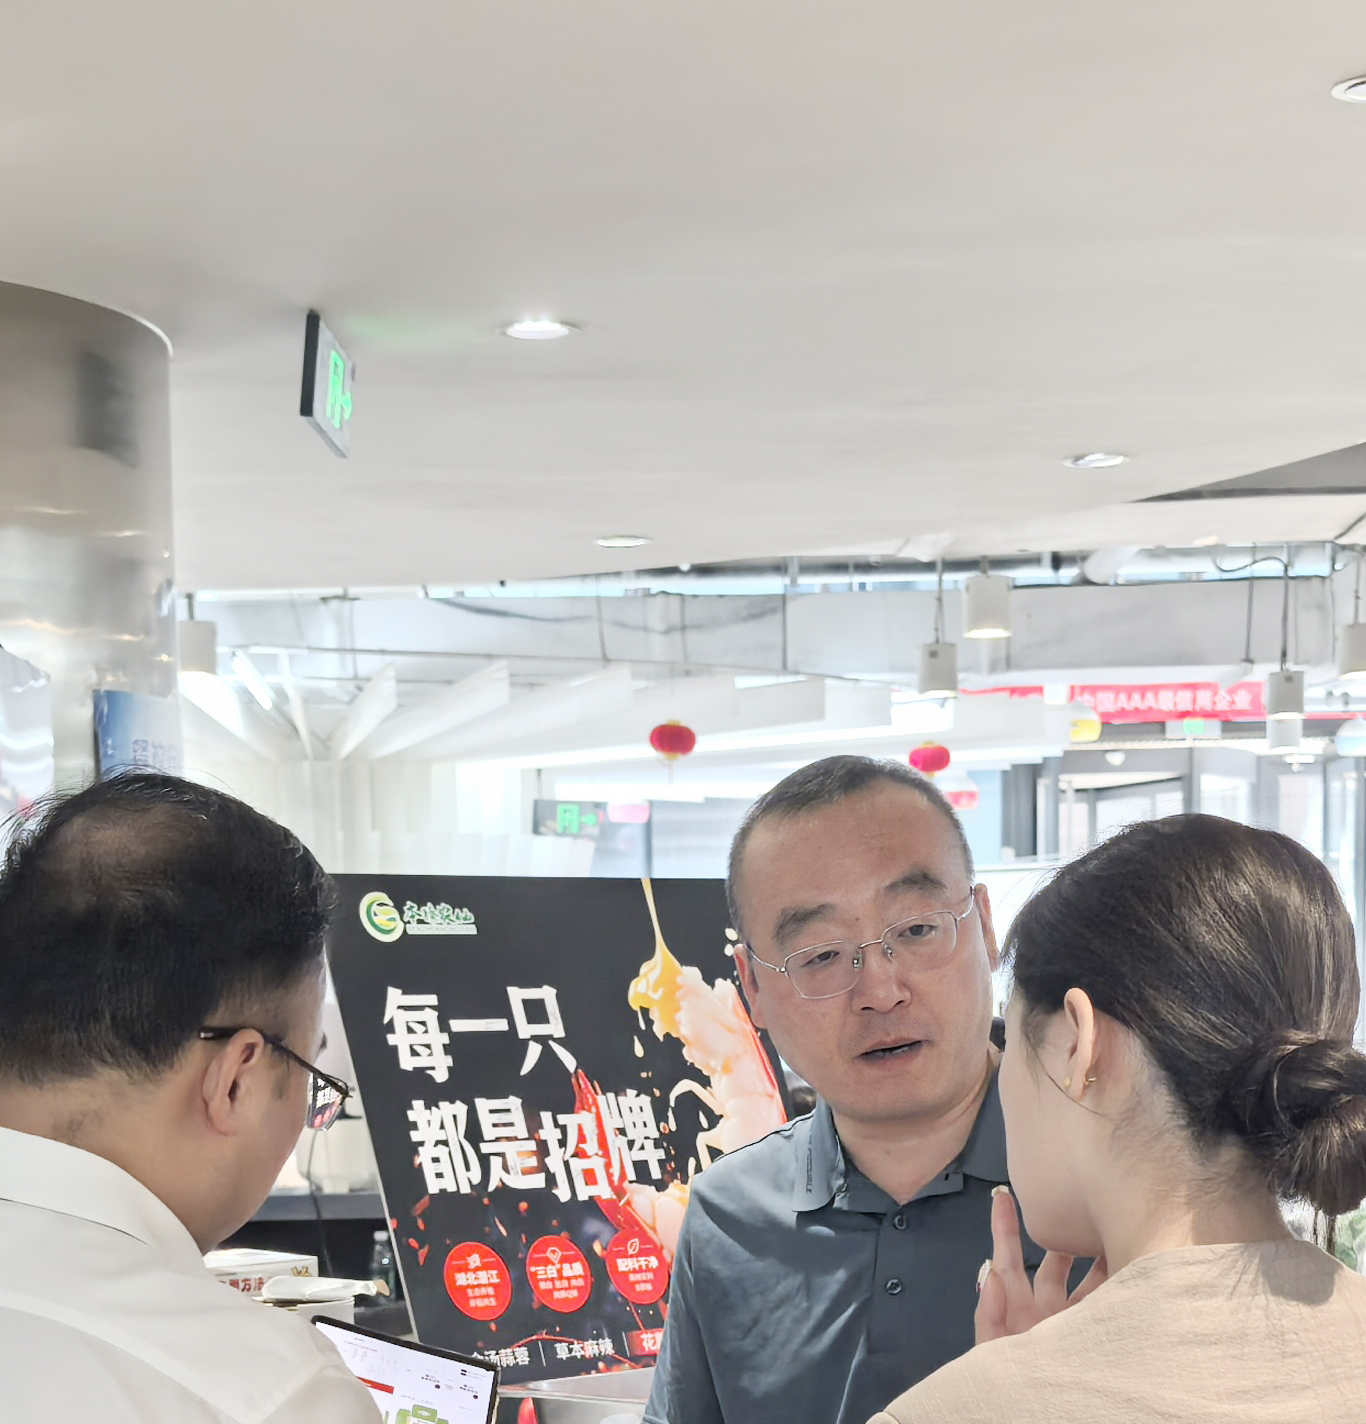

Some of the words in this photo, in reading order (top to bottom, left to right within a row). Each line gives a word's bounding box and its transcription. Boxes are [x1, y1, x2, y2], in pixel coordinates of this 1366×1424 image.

[383, 985, 578, 1083] 每一只
[407, 1088, 666, 1203] 都是招牌
[553, 1337, 615, 1361] 草本麻辣
